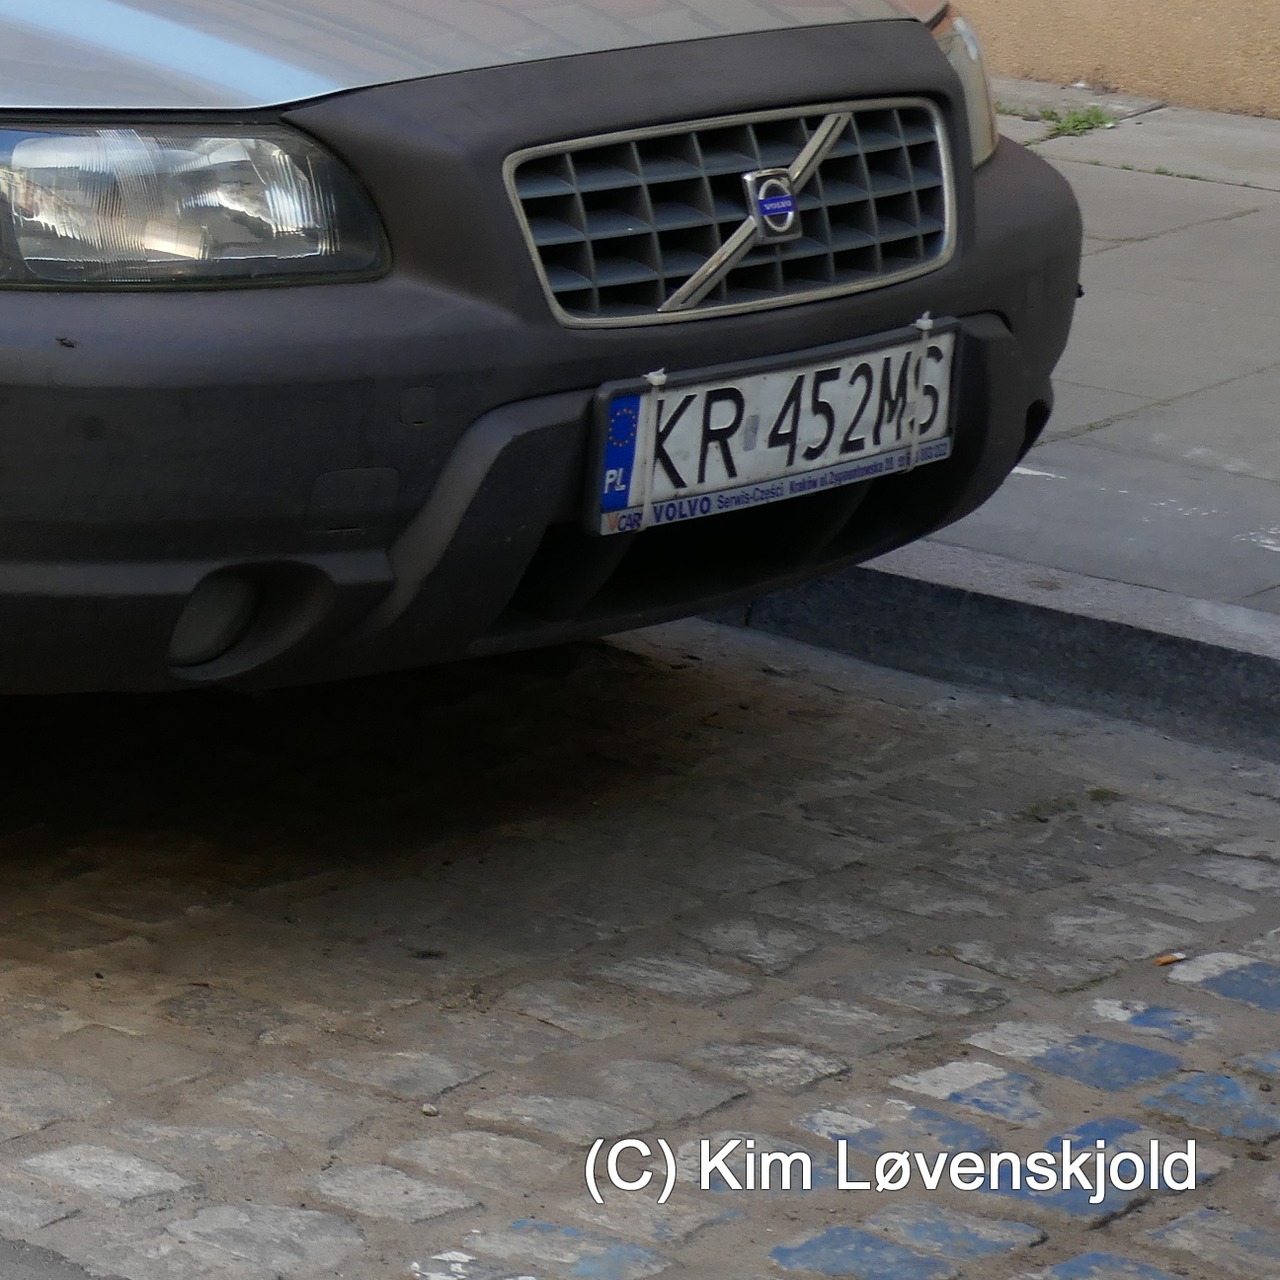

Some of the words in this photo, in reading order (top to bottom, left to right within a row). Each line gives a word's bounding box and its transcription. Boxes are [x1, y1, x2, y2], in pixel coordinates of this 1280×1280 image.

[764, 199, 792, 210] VOLVO
[652, 386, 746, 489] KR
[767, 345, 944, 467] 452MS
[603, 468, 627, 495] PL
[653, 496, 711, 524] VOLVO
